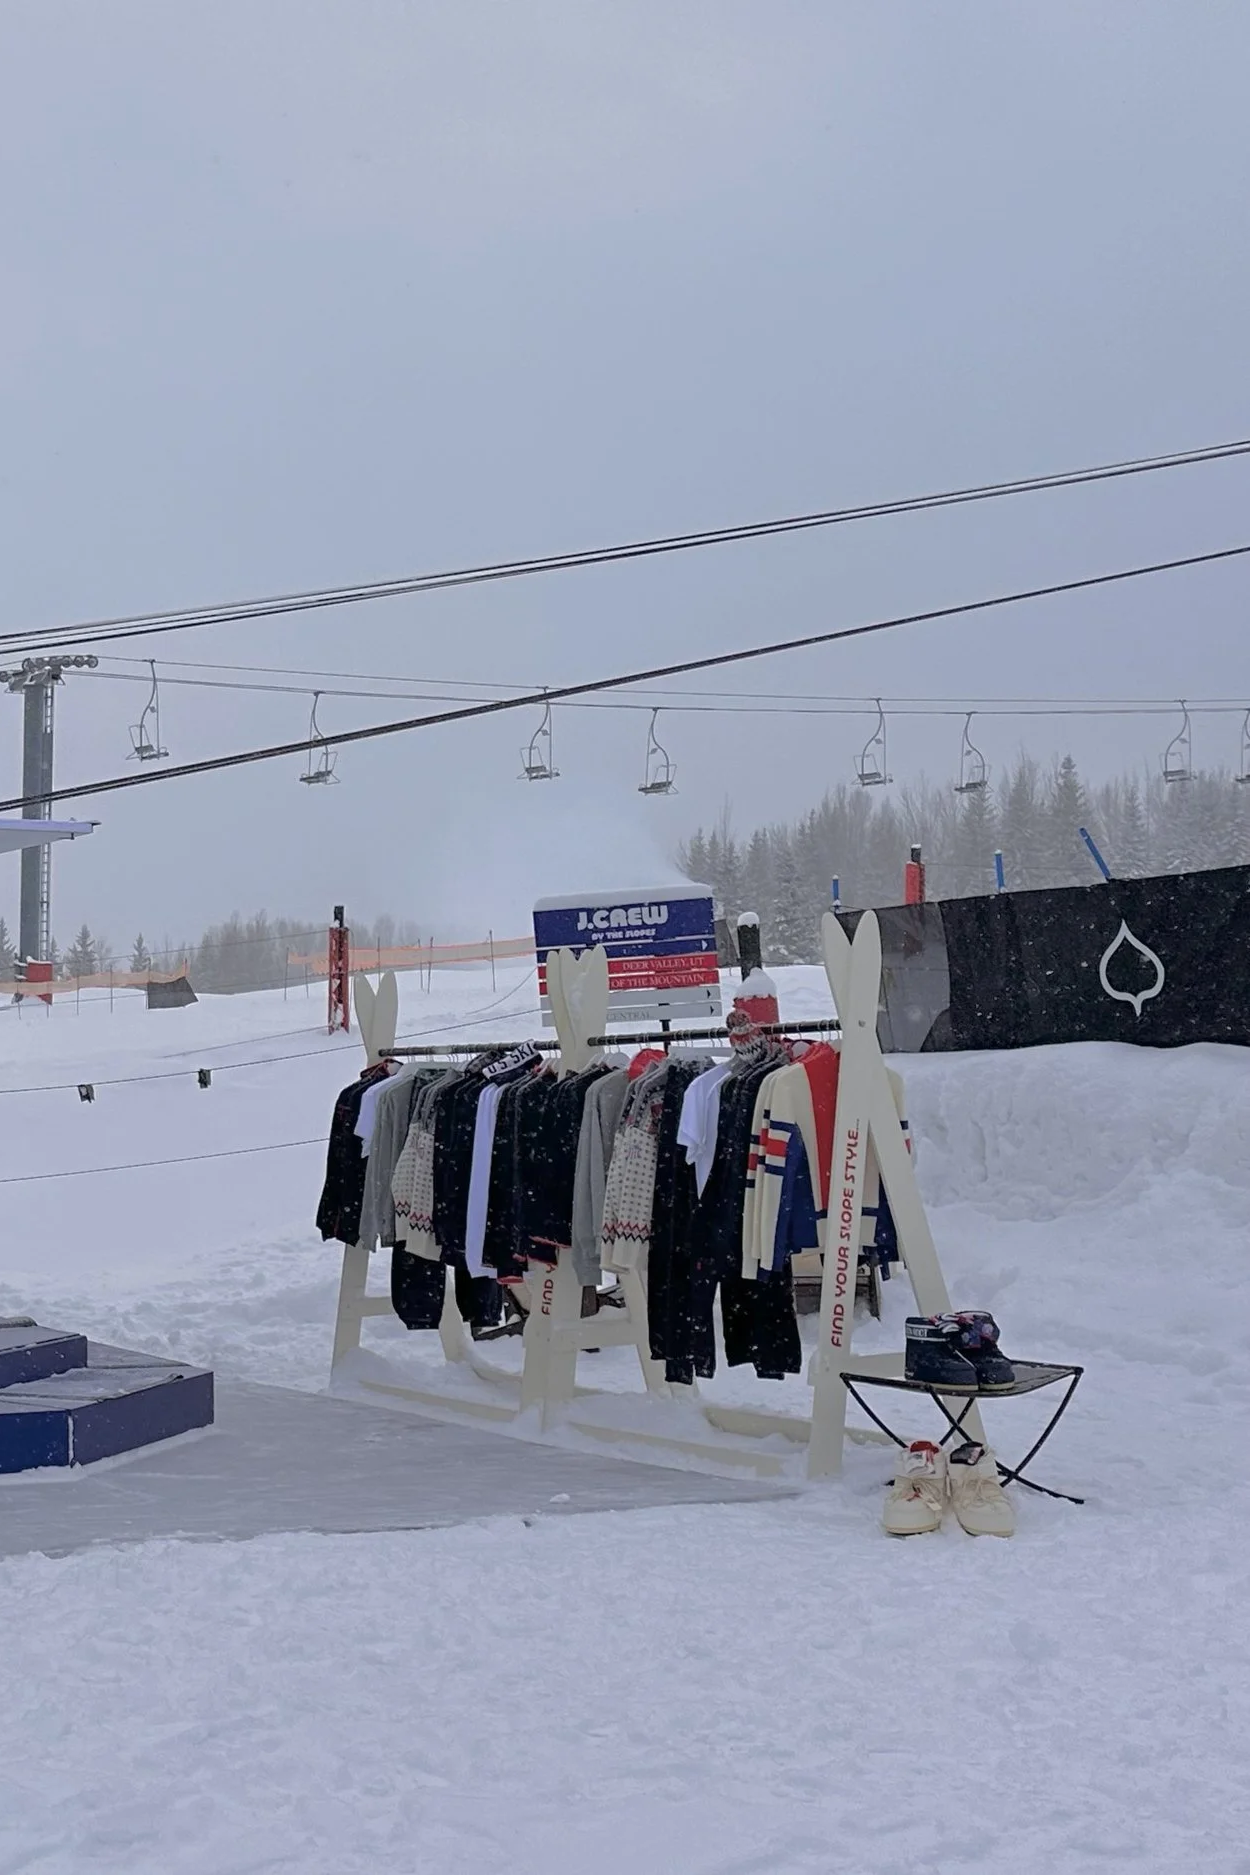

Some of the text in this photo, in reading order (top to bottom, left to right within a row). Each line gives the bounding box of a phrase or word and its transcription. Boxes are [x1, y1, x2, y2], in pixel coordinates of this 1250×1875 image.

[577, 904, 669, 931] J.CREW
[591, 928, 657, 941] BY THE SLOPES
[622, 959, 649, 971] DEER
[689, 956, 706, 967] UT
[611, 973, 706, 988] OF THE MOUNTAIN
[488, 1042, 535, 1074] US SKI
[840, 1188, 855, 1241] SLOPE
[835, 1246, 850, 1298] YOUR
[541, 1279, 554, 1315] FIND
[831, 1303, 845, 1348] FIND
